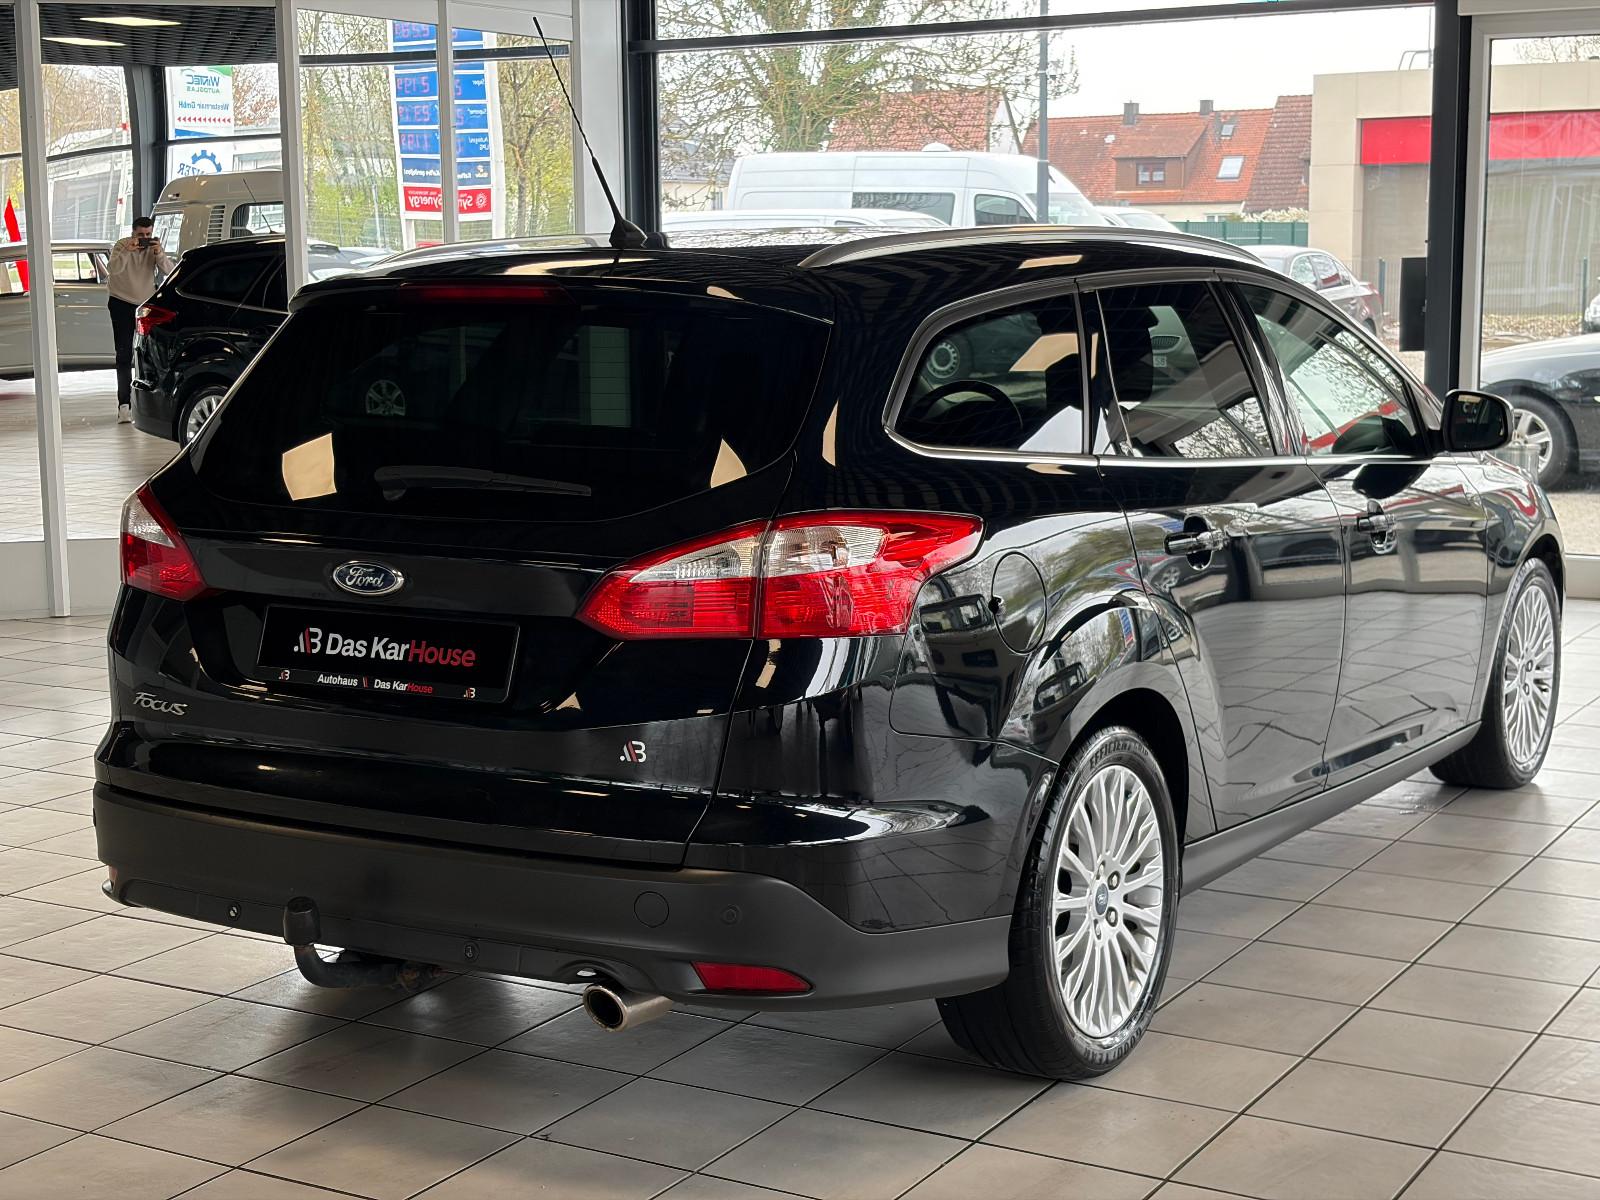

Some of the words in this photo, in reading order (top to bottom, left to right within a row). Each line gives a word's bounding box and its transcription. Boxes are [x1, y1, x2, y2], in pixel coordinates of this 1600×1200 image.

[345, 566, 385, 588] Ford
[325, 633, 367, 658] Das
[370, 636, 476, 667] KarHouse
[317, 674, 359, 687] Autohaus
[374, 679, 391, 690] Das
[392, 681, 433, 694] KarHouse
